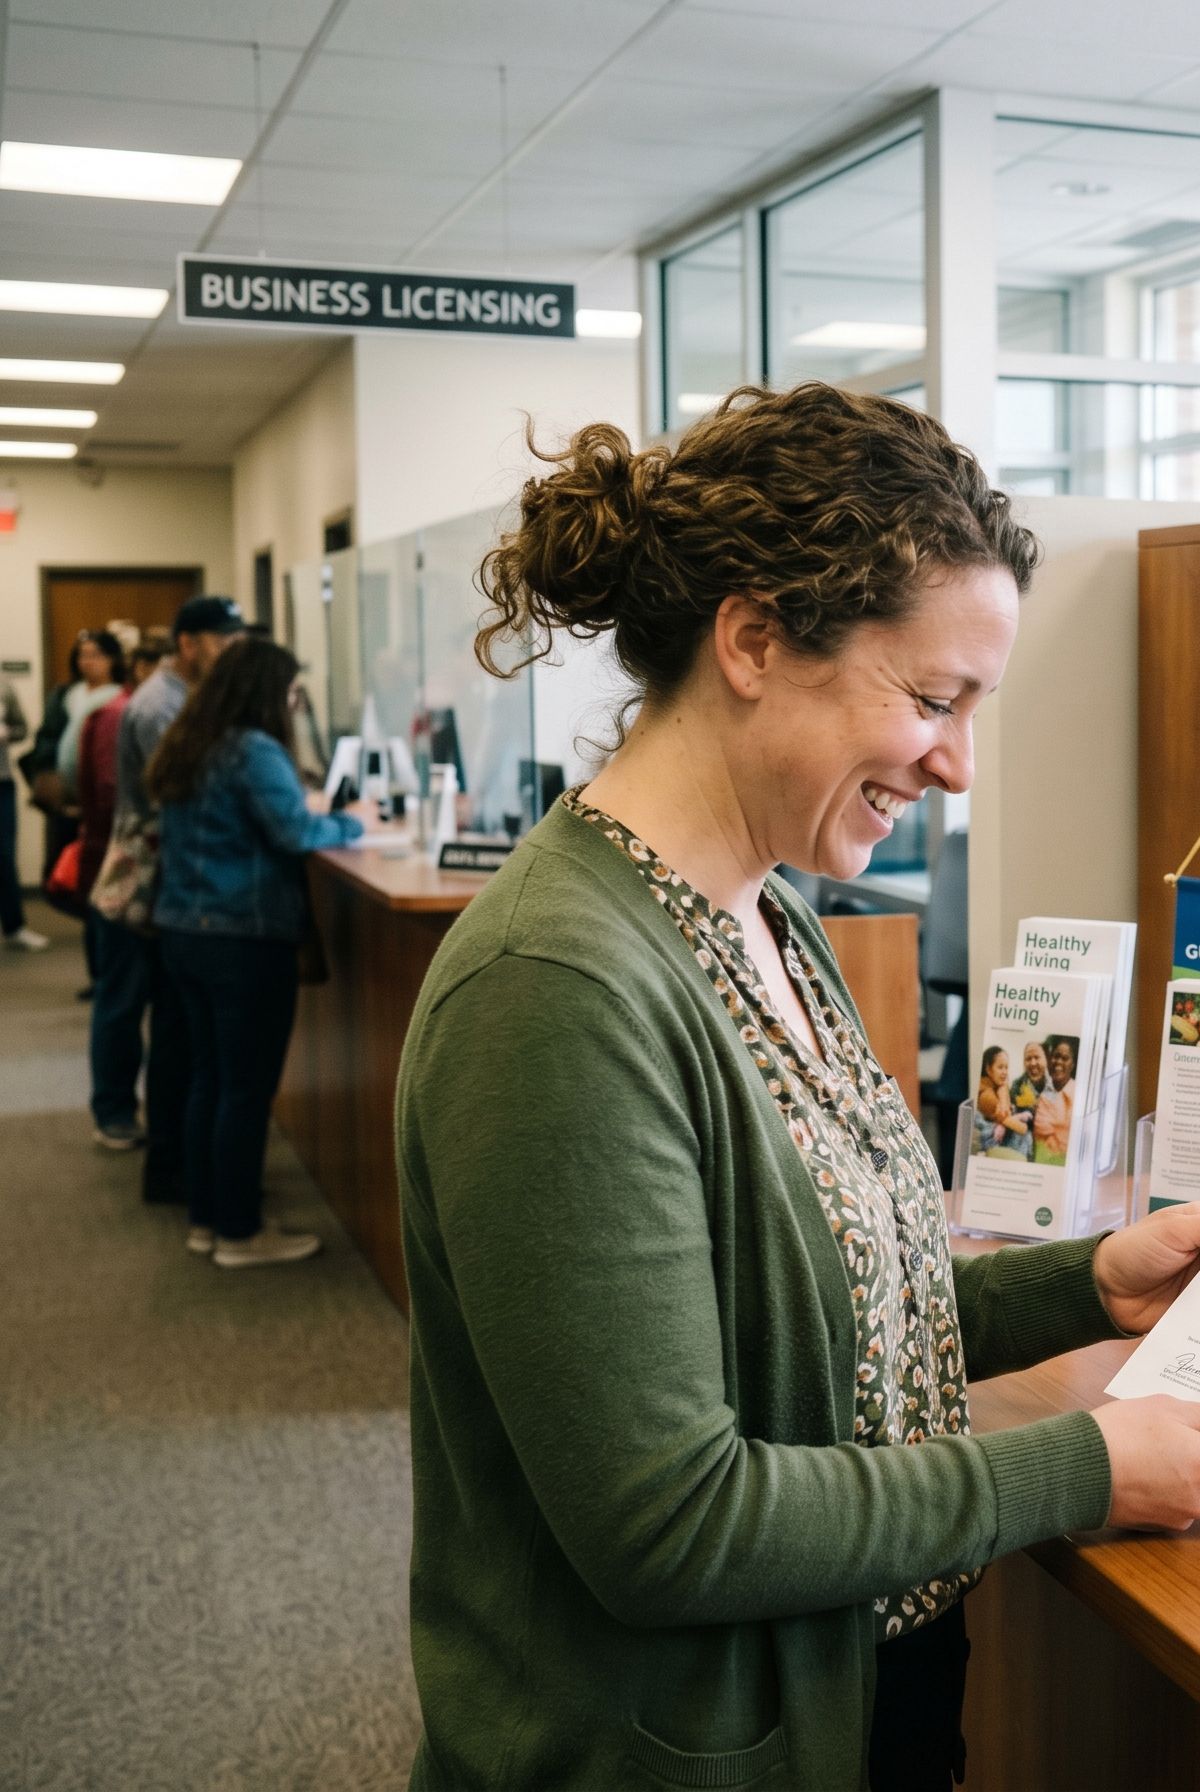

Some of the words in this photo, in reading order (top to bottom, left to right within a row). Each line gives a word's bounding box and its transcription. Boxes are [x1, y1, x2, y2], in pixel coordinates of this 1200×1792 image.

[201, 273, 370, 317] BUSINESS
[382, 284, 561, 328] LICENSING
[1025, 932, 1091, 956] Healthy
[995, 982, 1061, 1008] Healthy
[993, 1002, 1040, 1026] living
